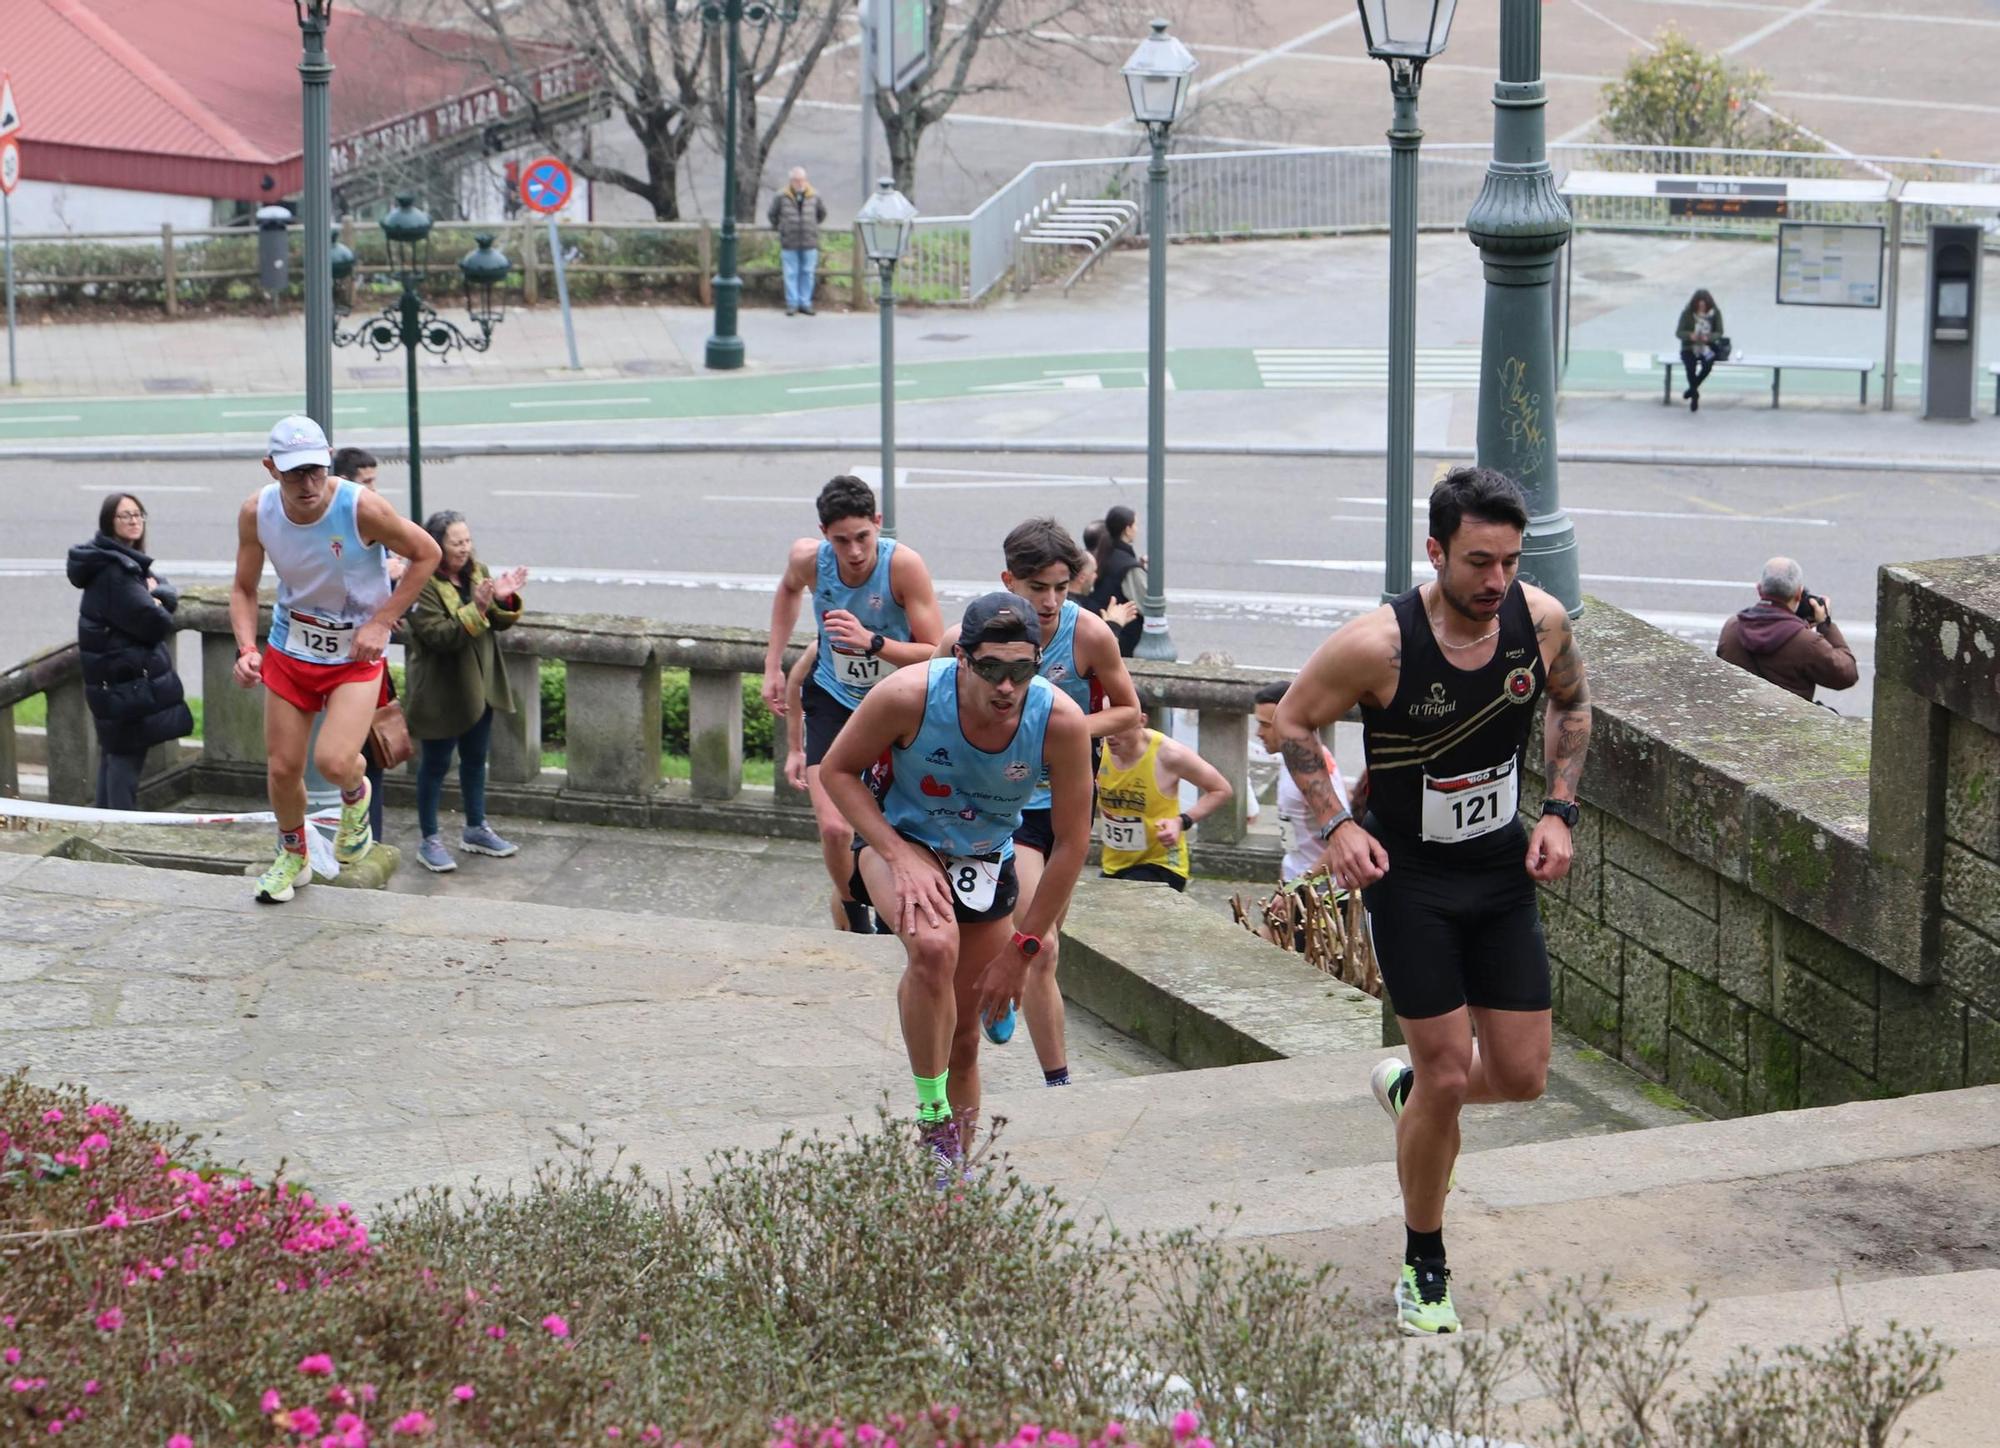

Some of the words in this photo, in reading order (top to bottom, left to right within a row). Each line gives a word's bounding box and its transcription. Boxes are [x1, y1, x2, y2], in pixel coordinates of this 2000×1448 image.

[302, 630, 338, 653] 125
[847, 660, 879, 678] 417
[1408, 703, 1419, 716] El
[1421, 700, 1456, 718] Trigal
[1452, 791, 1498, 830] 121
[1105, 823, 1134, 844] 357
[948, 866, 977, 893] 8
